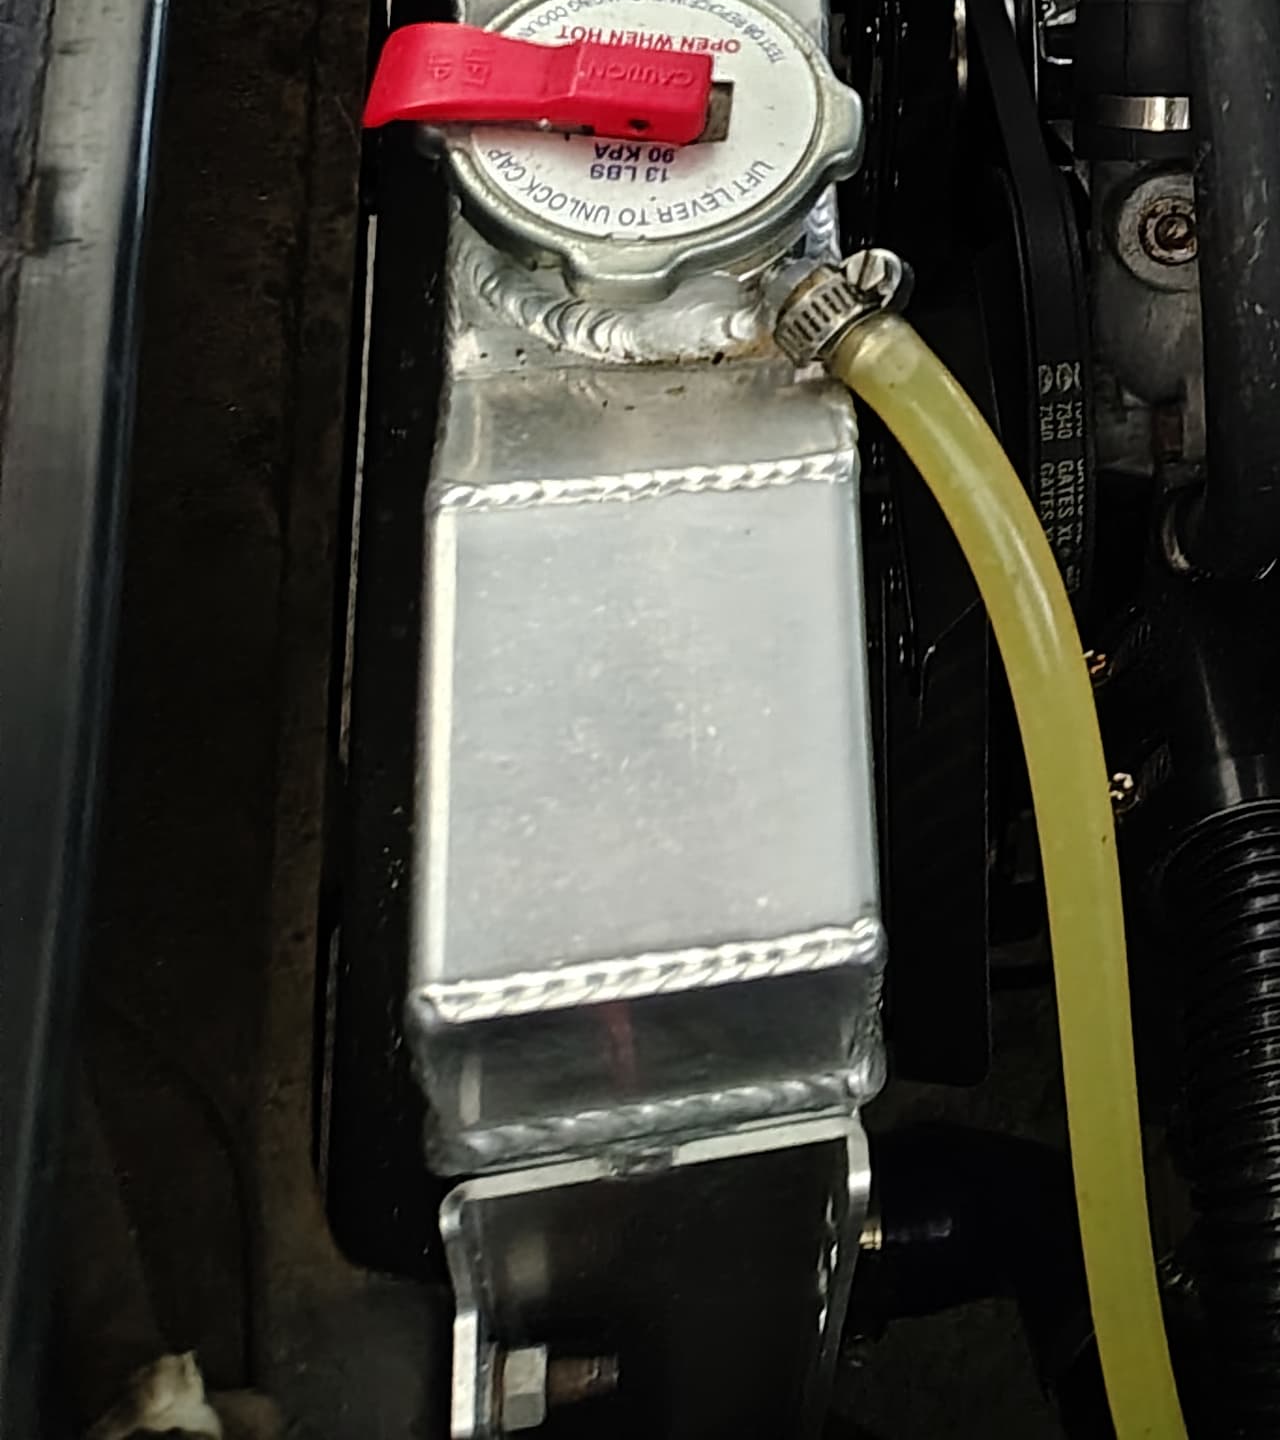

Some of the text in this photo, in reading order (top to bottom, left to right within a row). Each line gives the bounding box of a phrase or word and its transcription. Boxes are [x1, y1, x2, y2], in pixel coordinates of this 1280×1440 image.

[555, 24, 741, 54] OPEN WHEN HOT
[579, 61, 692, 90] CAUTION
[592, 143, 675, 164] 90 KPA
[487, 147, 774, 226] LIFT LEVER TO UNLOCK CAP
[589, 163, 670, 182] 13 LBS
[1057, 459, 1074, 519] GATES
